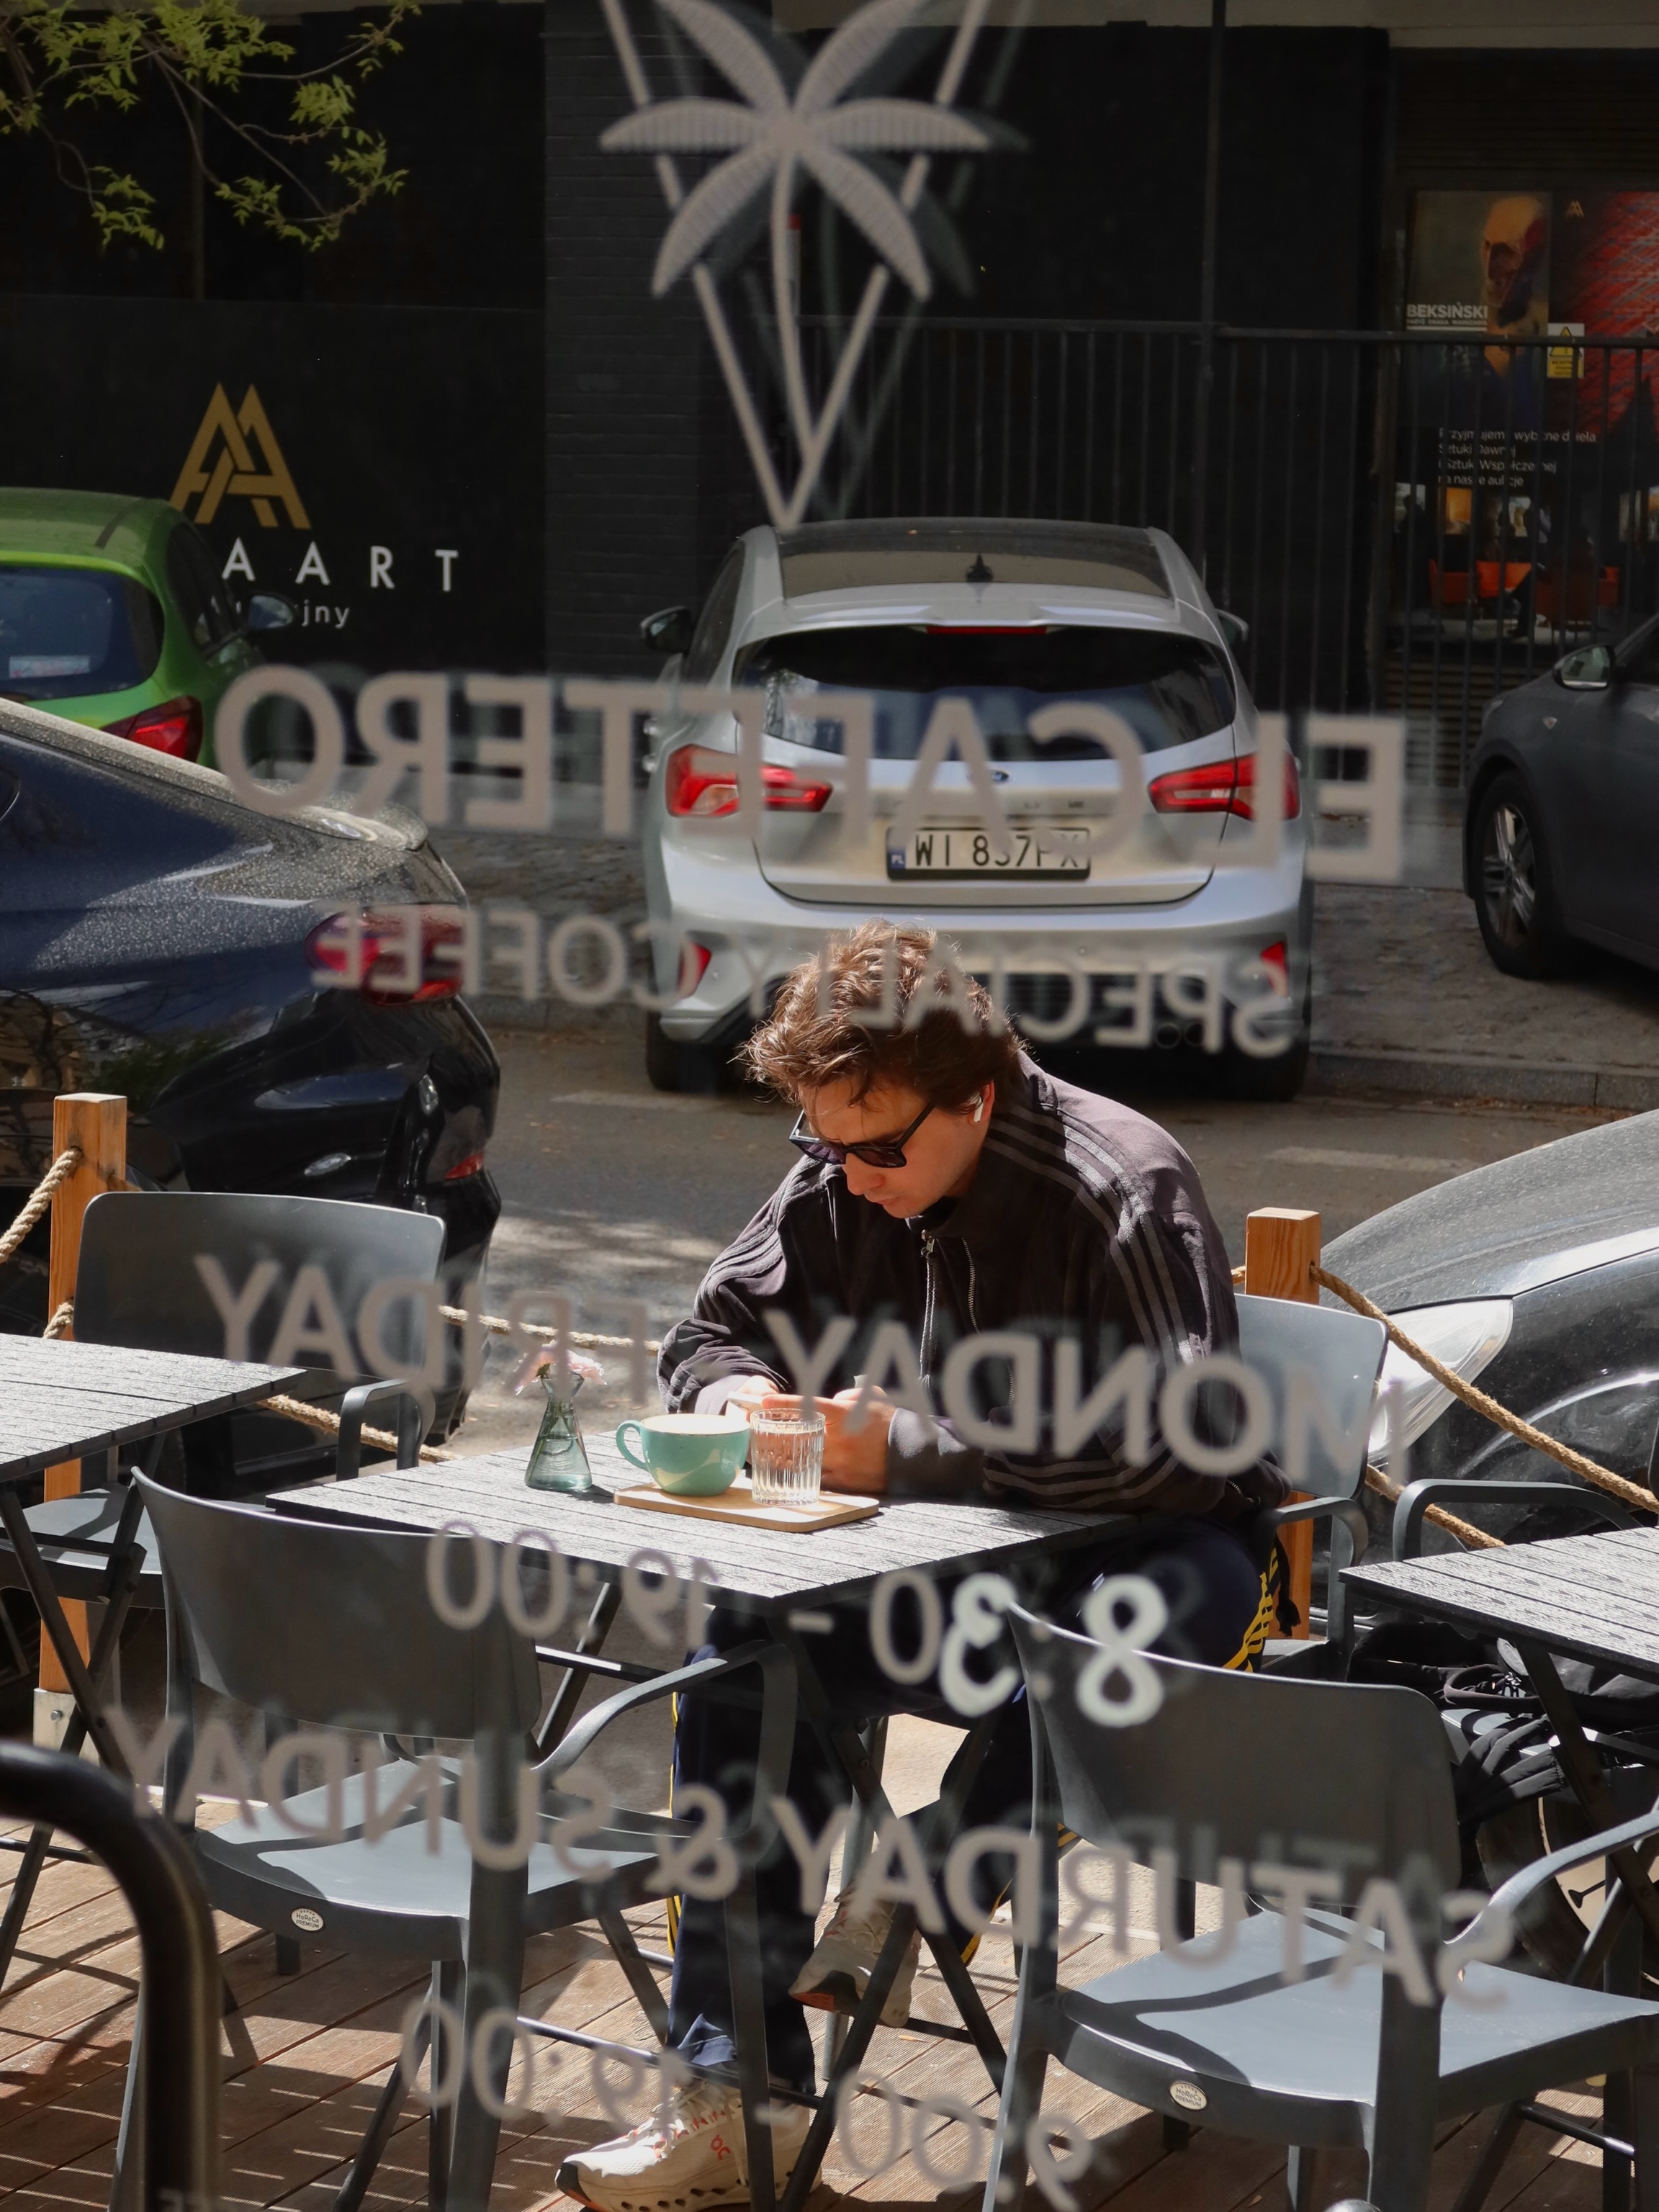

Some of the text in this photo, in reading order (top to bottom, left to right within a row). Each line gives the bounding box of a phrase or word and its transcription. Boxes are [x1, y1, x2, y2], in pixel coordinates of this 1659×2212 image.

[1406, 301, 1488, 318] BEKSIŃSKI
[296, 1919, 319, 1929] PREMIUM
[1175, 2095, 1202, 2108] PREMIUM
